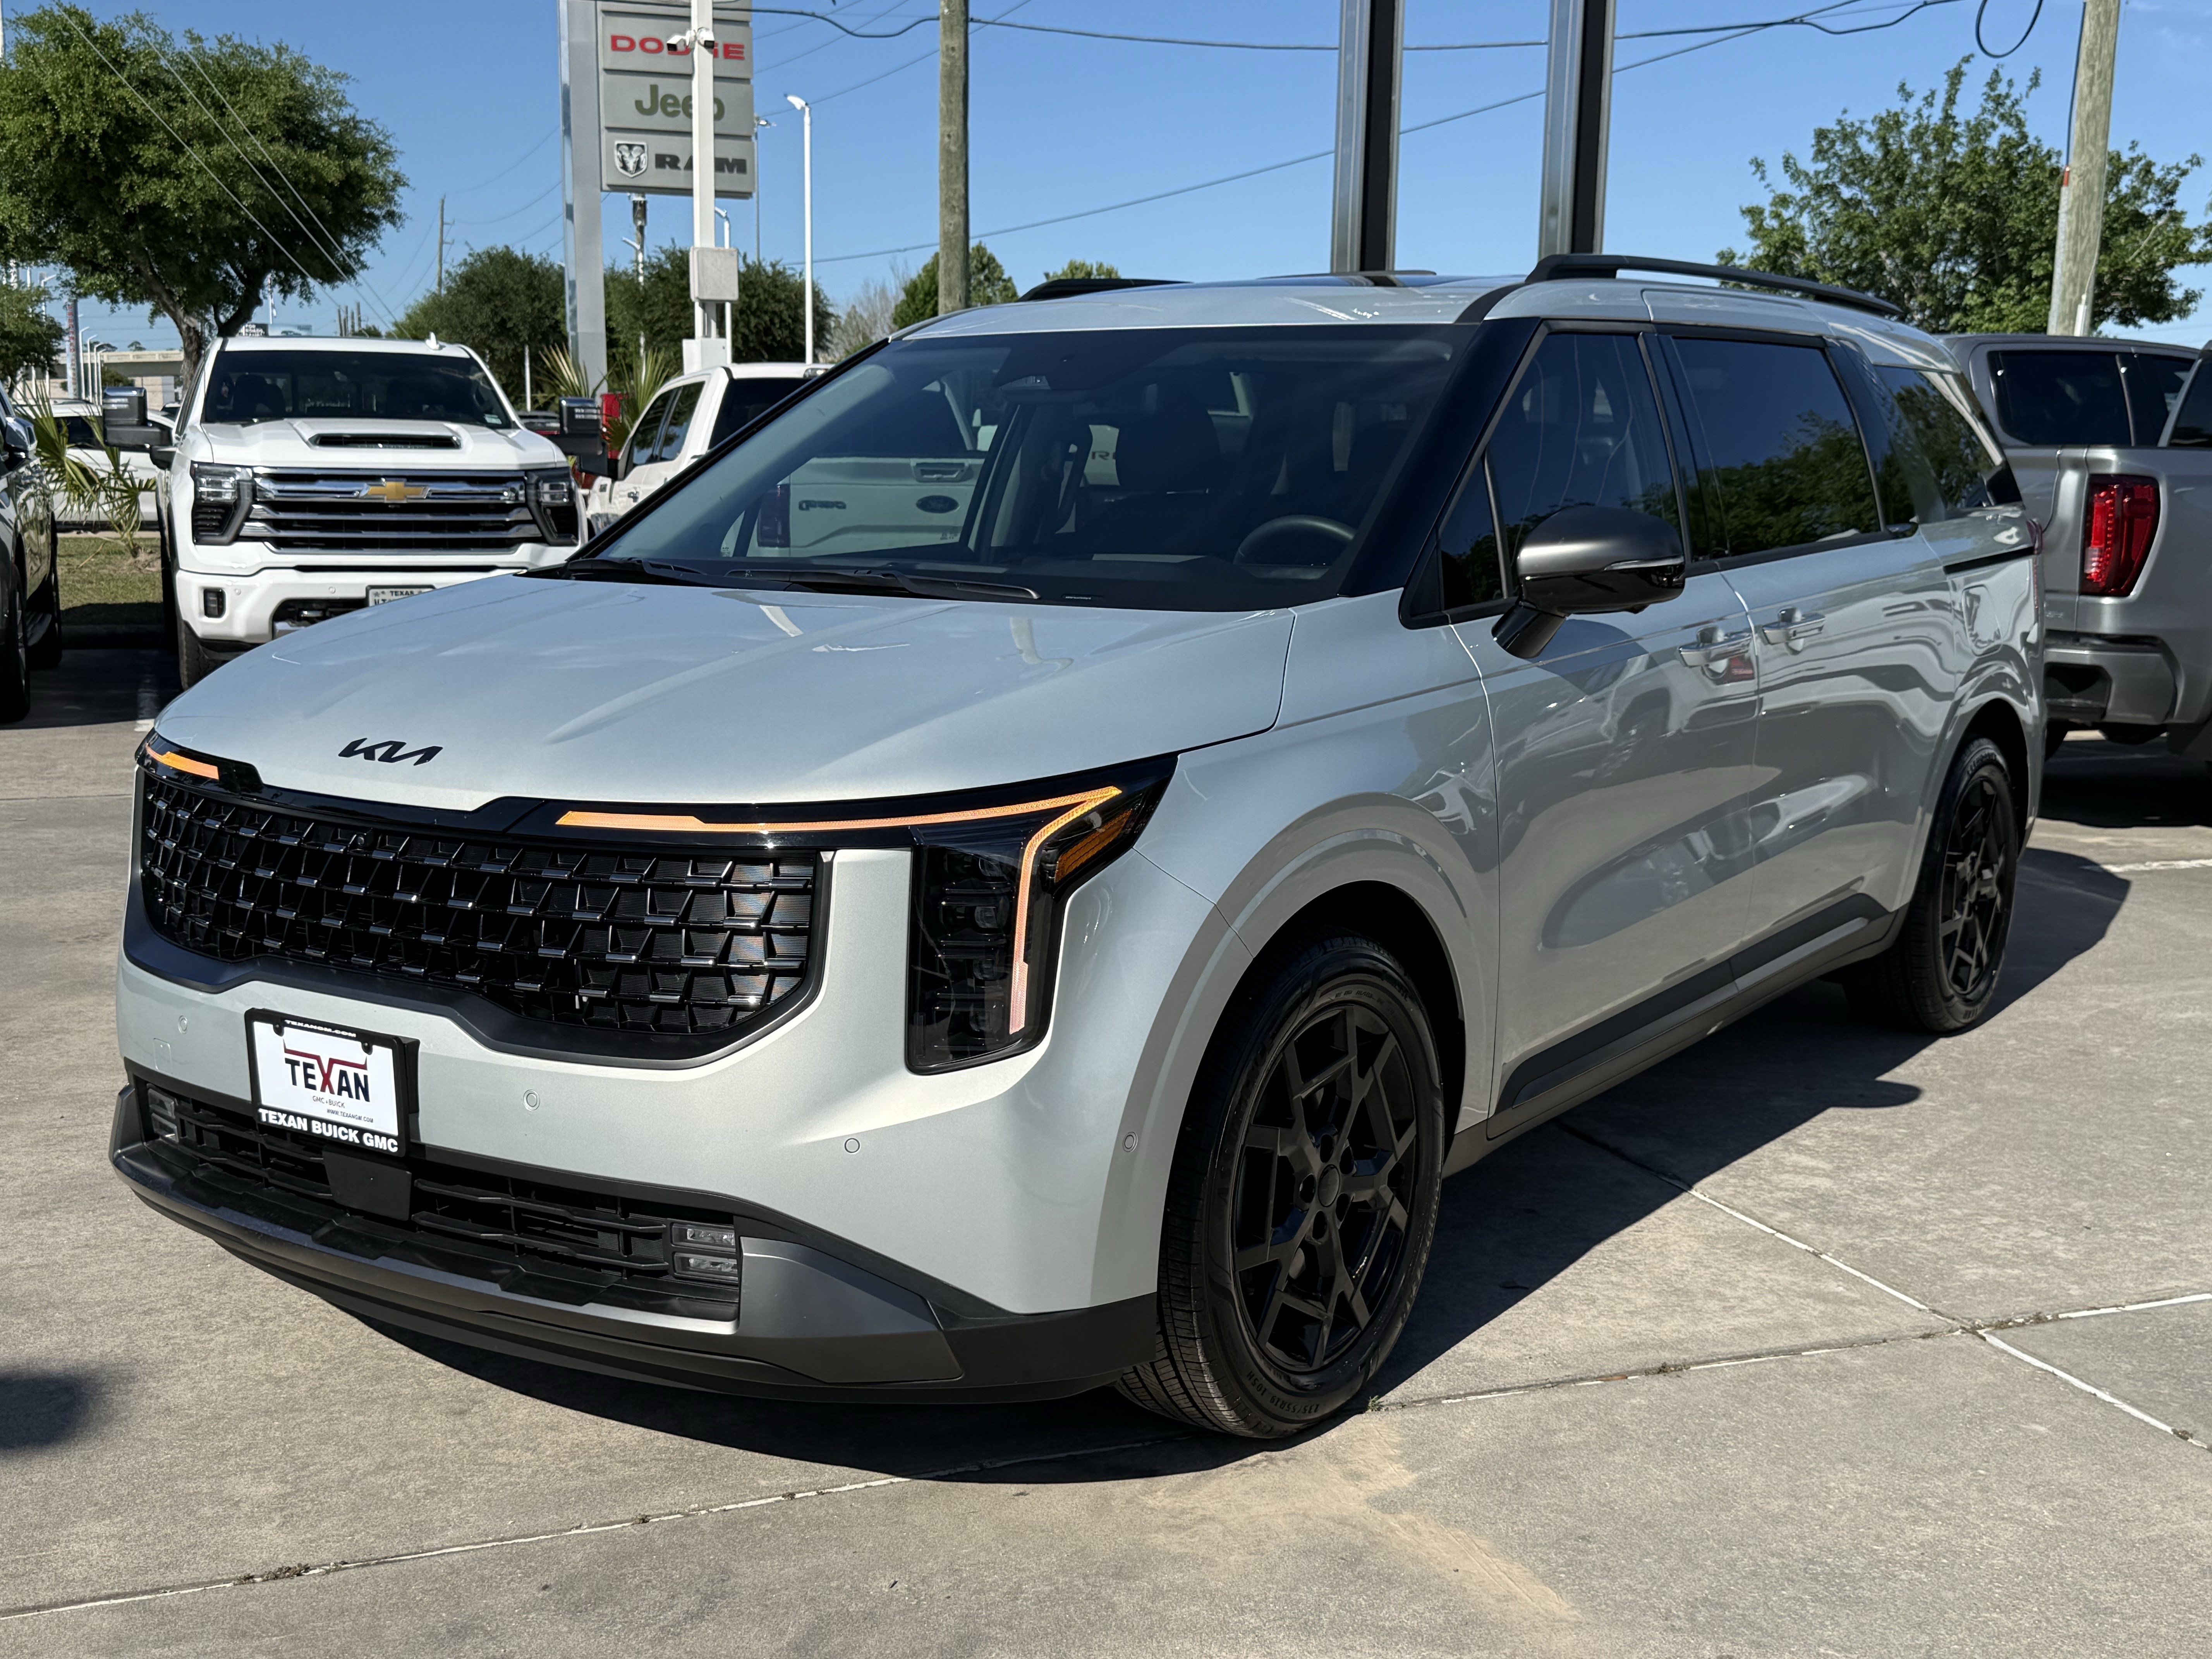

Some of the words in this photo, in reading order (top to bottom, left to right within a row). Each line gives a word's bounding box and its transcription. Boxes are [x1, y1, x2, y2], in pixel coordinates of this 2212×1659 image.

[611, 35, 745, 60] DOE
[338, 738, 443, 766] KIA
[285, 1055, 370, 1103] TEXAN
[329, 1099, 345, 1108] BUICK
[258, 1108, 307, 1131] TEXAN
[311, 1120, 360, 1144] BUICK
[363, 1132, 398, 1152] GMC
